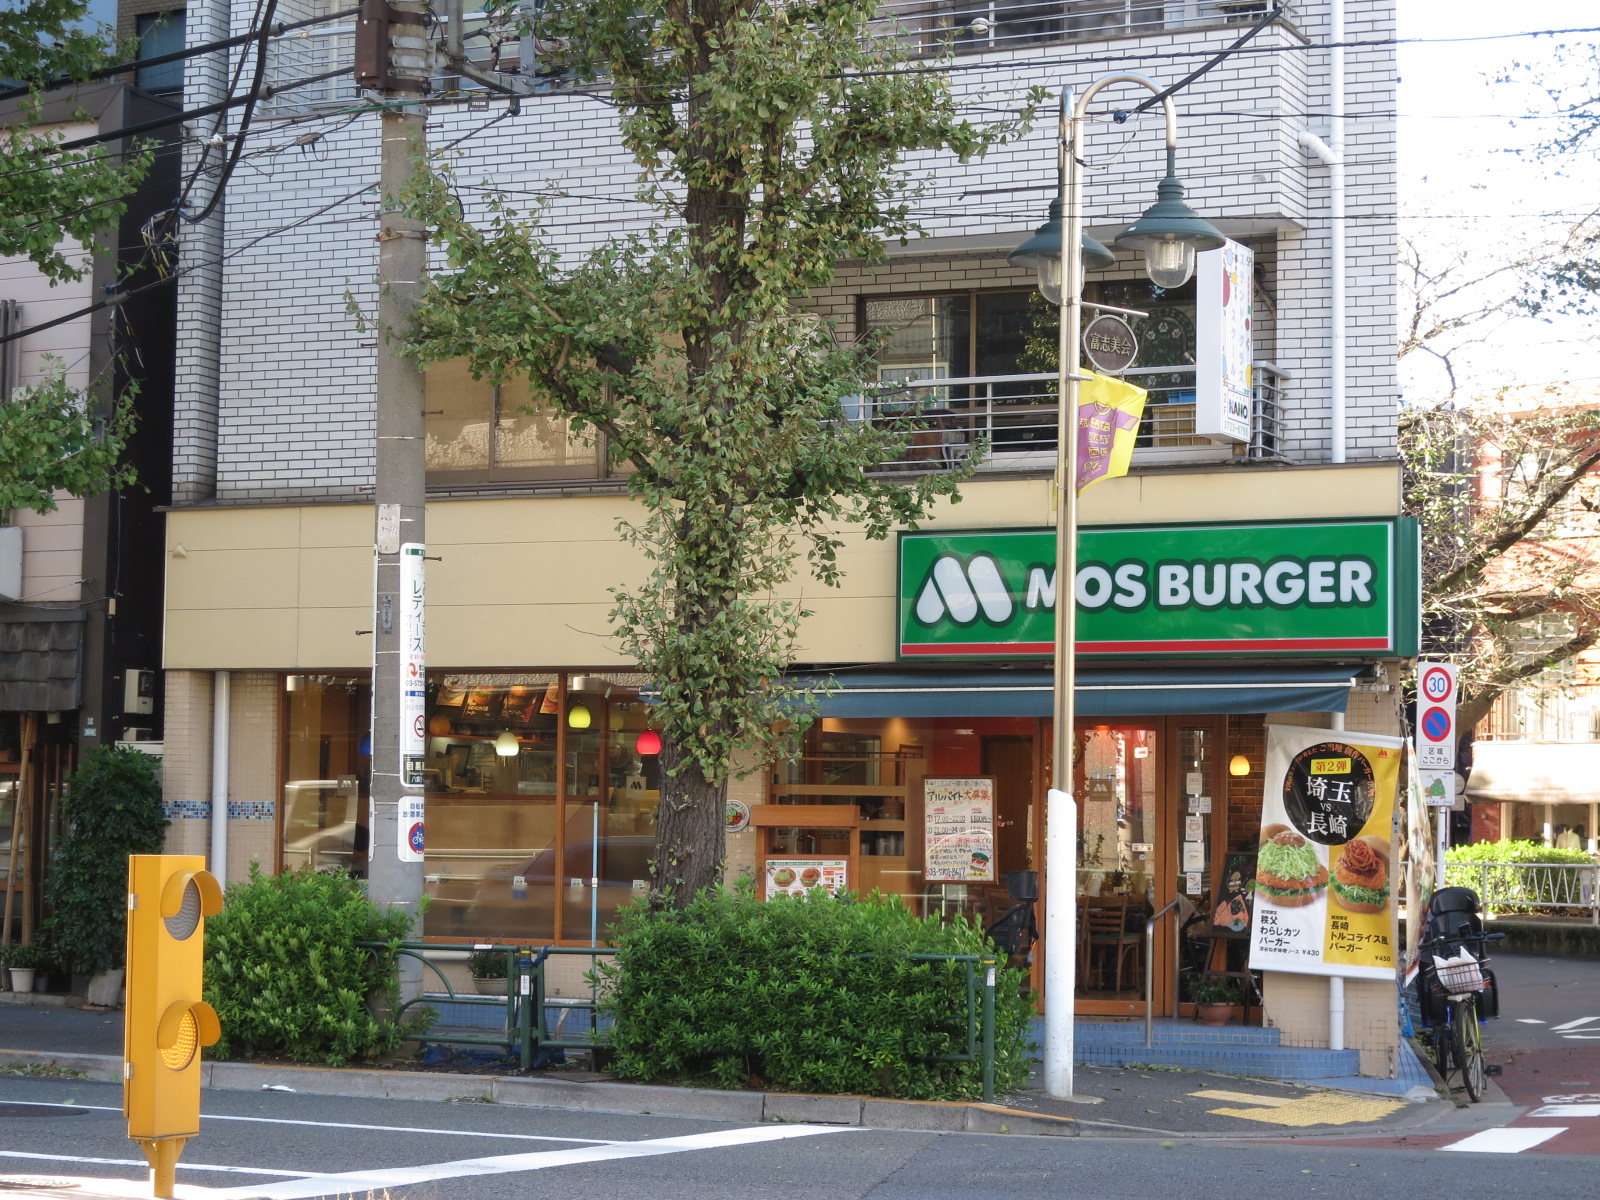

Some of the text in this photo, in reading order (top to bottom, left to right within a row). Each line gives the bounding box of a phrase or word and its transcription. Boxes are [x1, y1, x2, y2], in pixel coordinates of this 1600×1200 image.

[1090, 333, 1132, 356] 富志美会
[1228, 398, 1248, 420] KANO
[1025, 564, 1145, 608] MOS
[1158, 560, 1372, 606] BURGER
[1428, 676, 1445, 693] 30
[1428, 747, 1444, 755] 区域
[1422, 756, 1450, 765] ここから
[1315, 760, 1347, 773] 第2弾
[1306, 775, 1354, 804] 埼玉
[1306, 811, 1348, 839] 長崎
[1260, 915, 1278, 926] 秩父
[1330, 920, 1349, 931] 長崎
[1260, 926, 1301, 937] わらじカツ
[1259, 936, 1291, 947] バーガー
[1330, 931, 1389, 946] トルコライス風
[1302, 949, 1320, 957] ¥430
[1329, 942, 1363, 953] バーガー
[1374, 955, 1391, 963] ¥450
